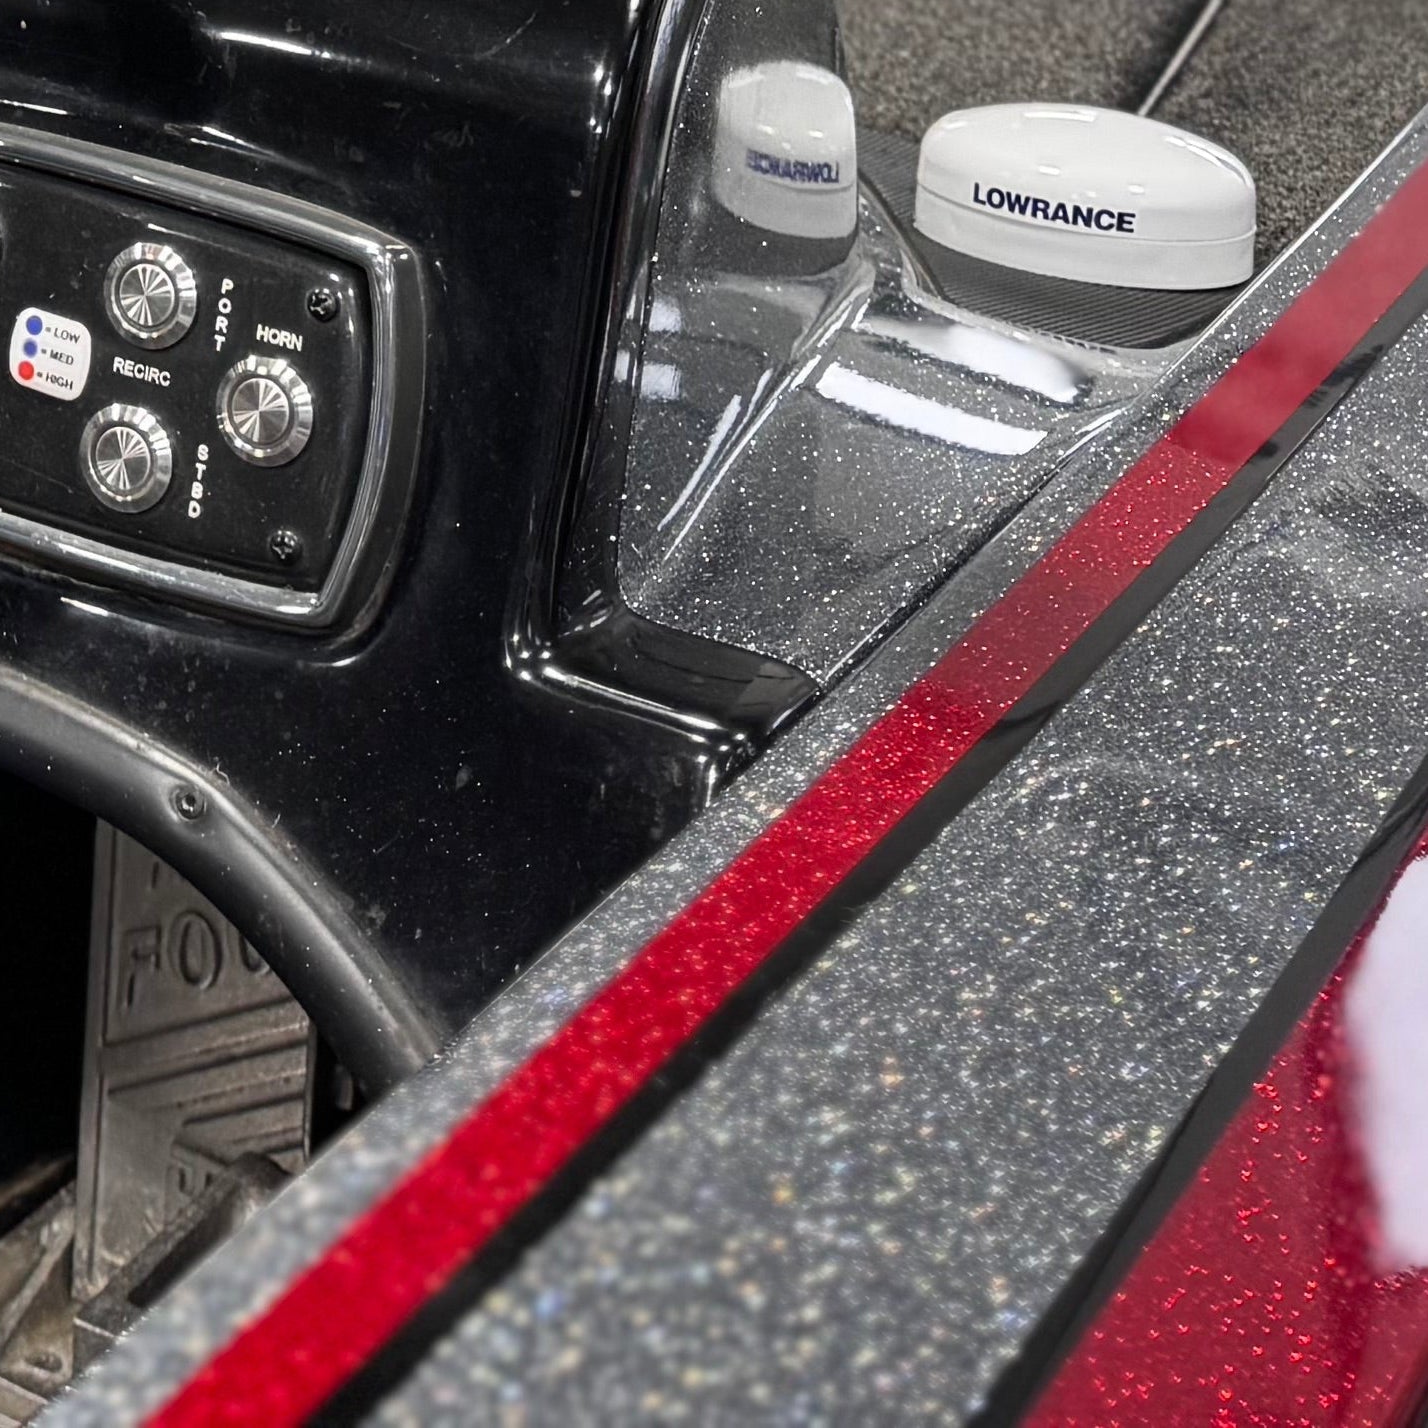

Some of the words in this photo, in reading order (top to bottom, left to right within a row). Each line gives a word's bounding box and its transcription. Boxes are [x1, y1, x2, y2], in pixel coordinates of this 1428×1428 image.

[972, 182, 1136, 233] LOWRANCE
[214, 278, 234, 351] PORT
[53, 327, 81, 344] LOW
[256, 324, 303, 351] HORN
[50, 349, 74, 365] MED
[113, 356, 171, 387] RECIRC
[46, 372, 74, 390] HIGH
[188, 444, 209, 518] STBD
